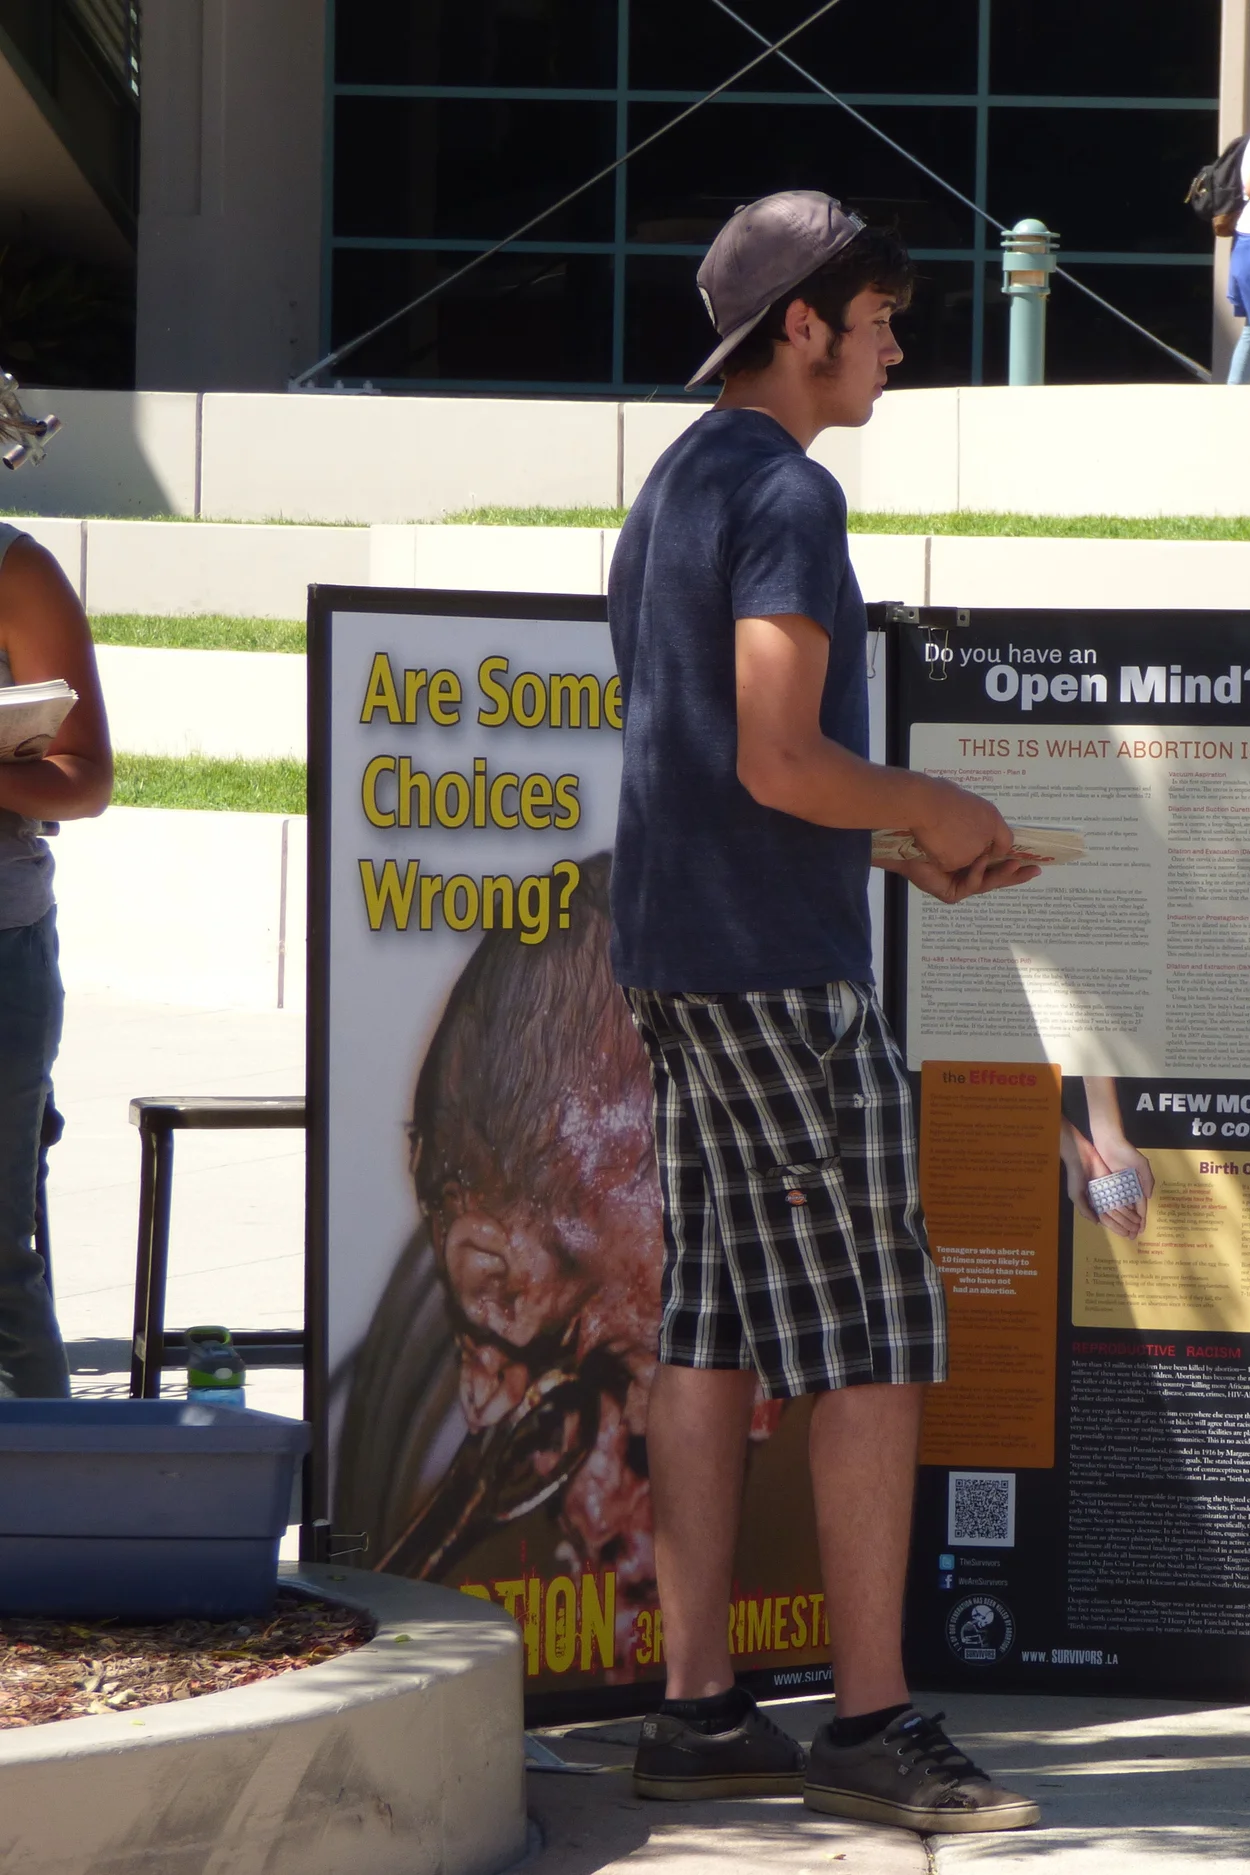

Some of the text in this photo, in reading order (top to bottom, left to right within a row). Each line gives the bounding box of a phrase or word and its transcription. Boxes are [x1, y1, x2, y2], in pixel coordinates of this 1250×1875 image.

[925, 643, 1097, 667] Do you have an
[359, 651, 623, 729] Are Some
[985, 664, 1108, 711] Open
[959, 739, 1010, 757] THIS
[1018, 739, 1039, 757] IS
[1046, 740, 1111, 758] WHAT
[1117, 741, 1233, 759] ABORTION
[361, 755, 580, 830] Choices
[357, 858, 580, 945] Wrong?
[942, 1070, 1037, 1086] the Effects
[1136, 1093, 1154, 1112] A
[1159, 1093, 1211, 1113] FEW
[1192, 1118, 1216, 1136] to
[1200, 1161, 1239, 1175] Birth
[936, 1246, 977, 1255] Teenagers
[937, 1266, 964, 1274] ttempt
[953, 1256, 976, 1264] times
[998, 1258, 1020, 1266] likely
[980, 1287, 1016, 1295] abortion.
[1072, 1342, 1241, 1358] REPRODUCTIVE RACISM
[1052, 1649, 1103, 1665] SURVIVORS
[774, 1666, 832, 1686] www.survi
